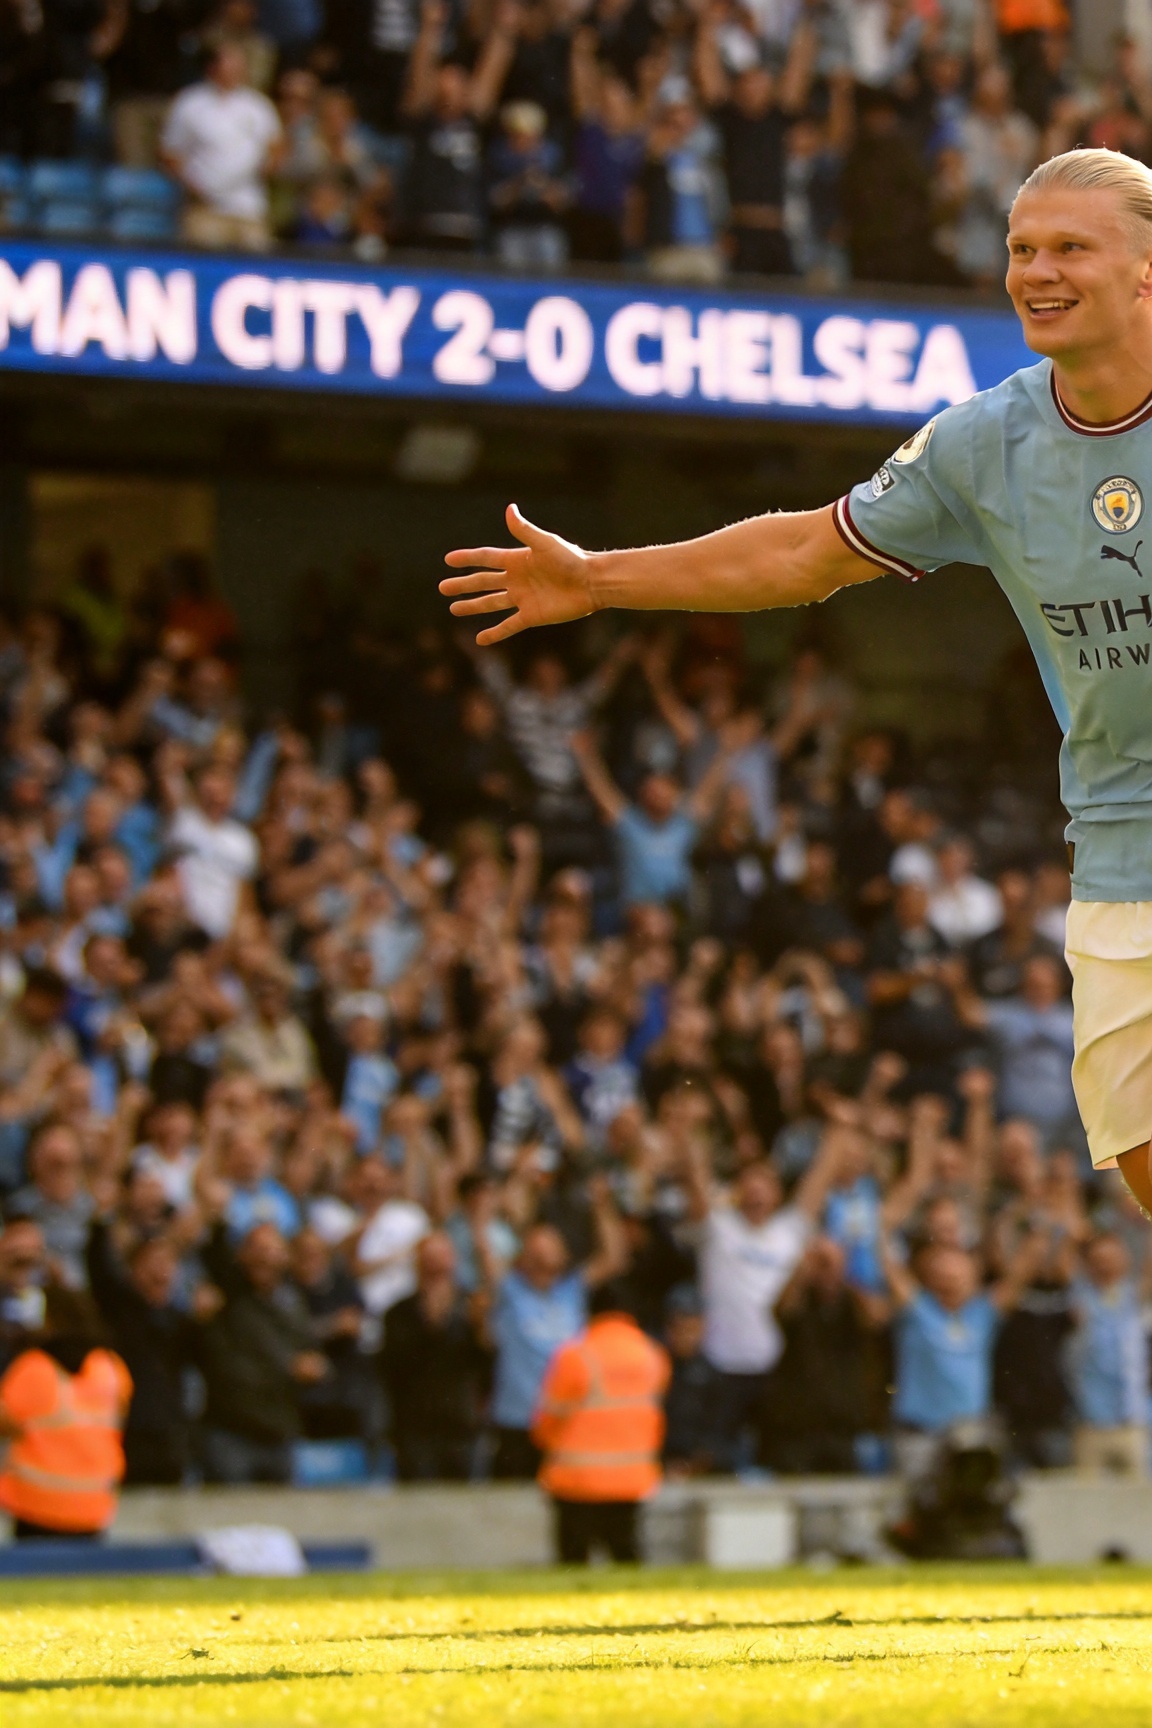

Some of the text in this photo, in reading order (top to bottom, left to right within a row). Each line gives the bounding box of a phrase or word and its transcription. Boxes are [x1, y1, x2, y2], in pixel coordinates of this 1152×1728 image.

[0, 258, 978, 412] MAN CITY 2-0 CHELSEA
